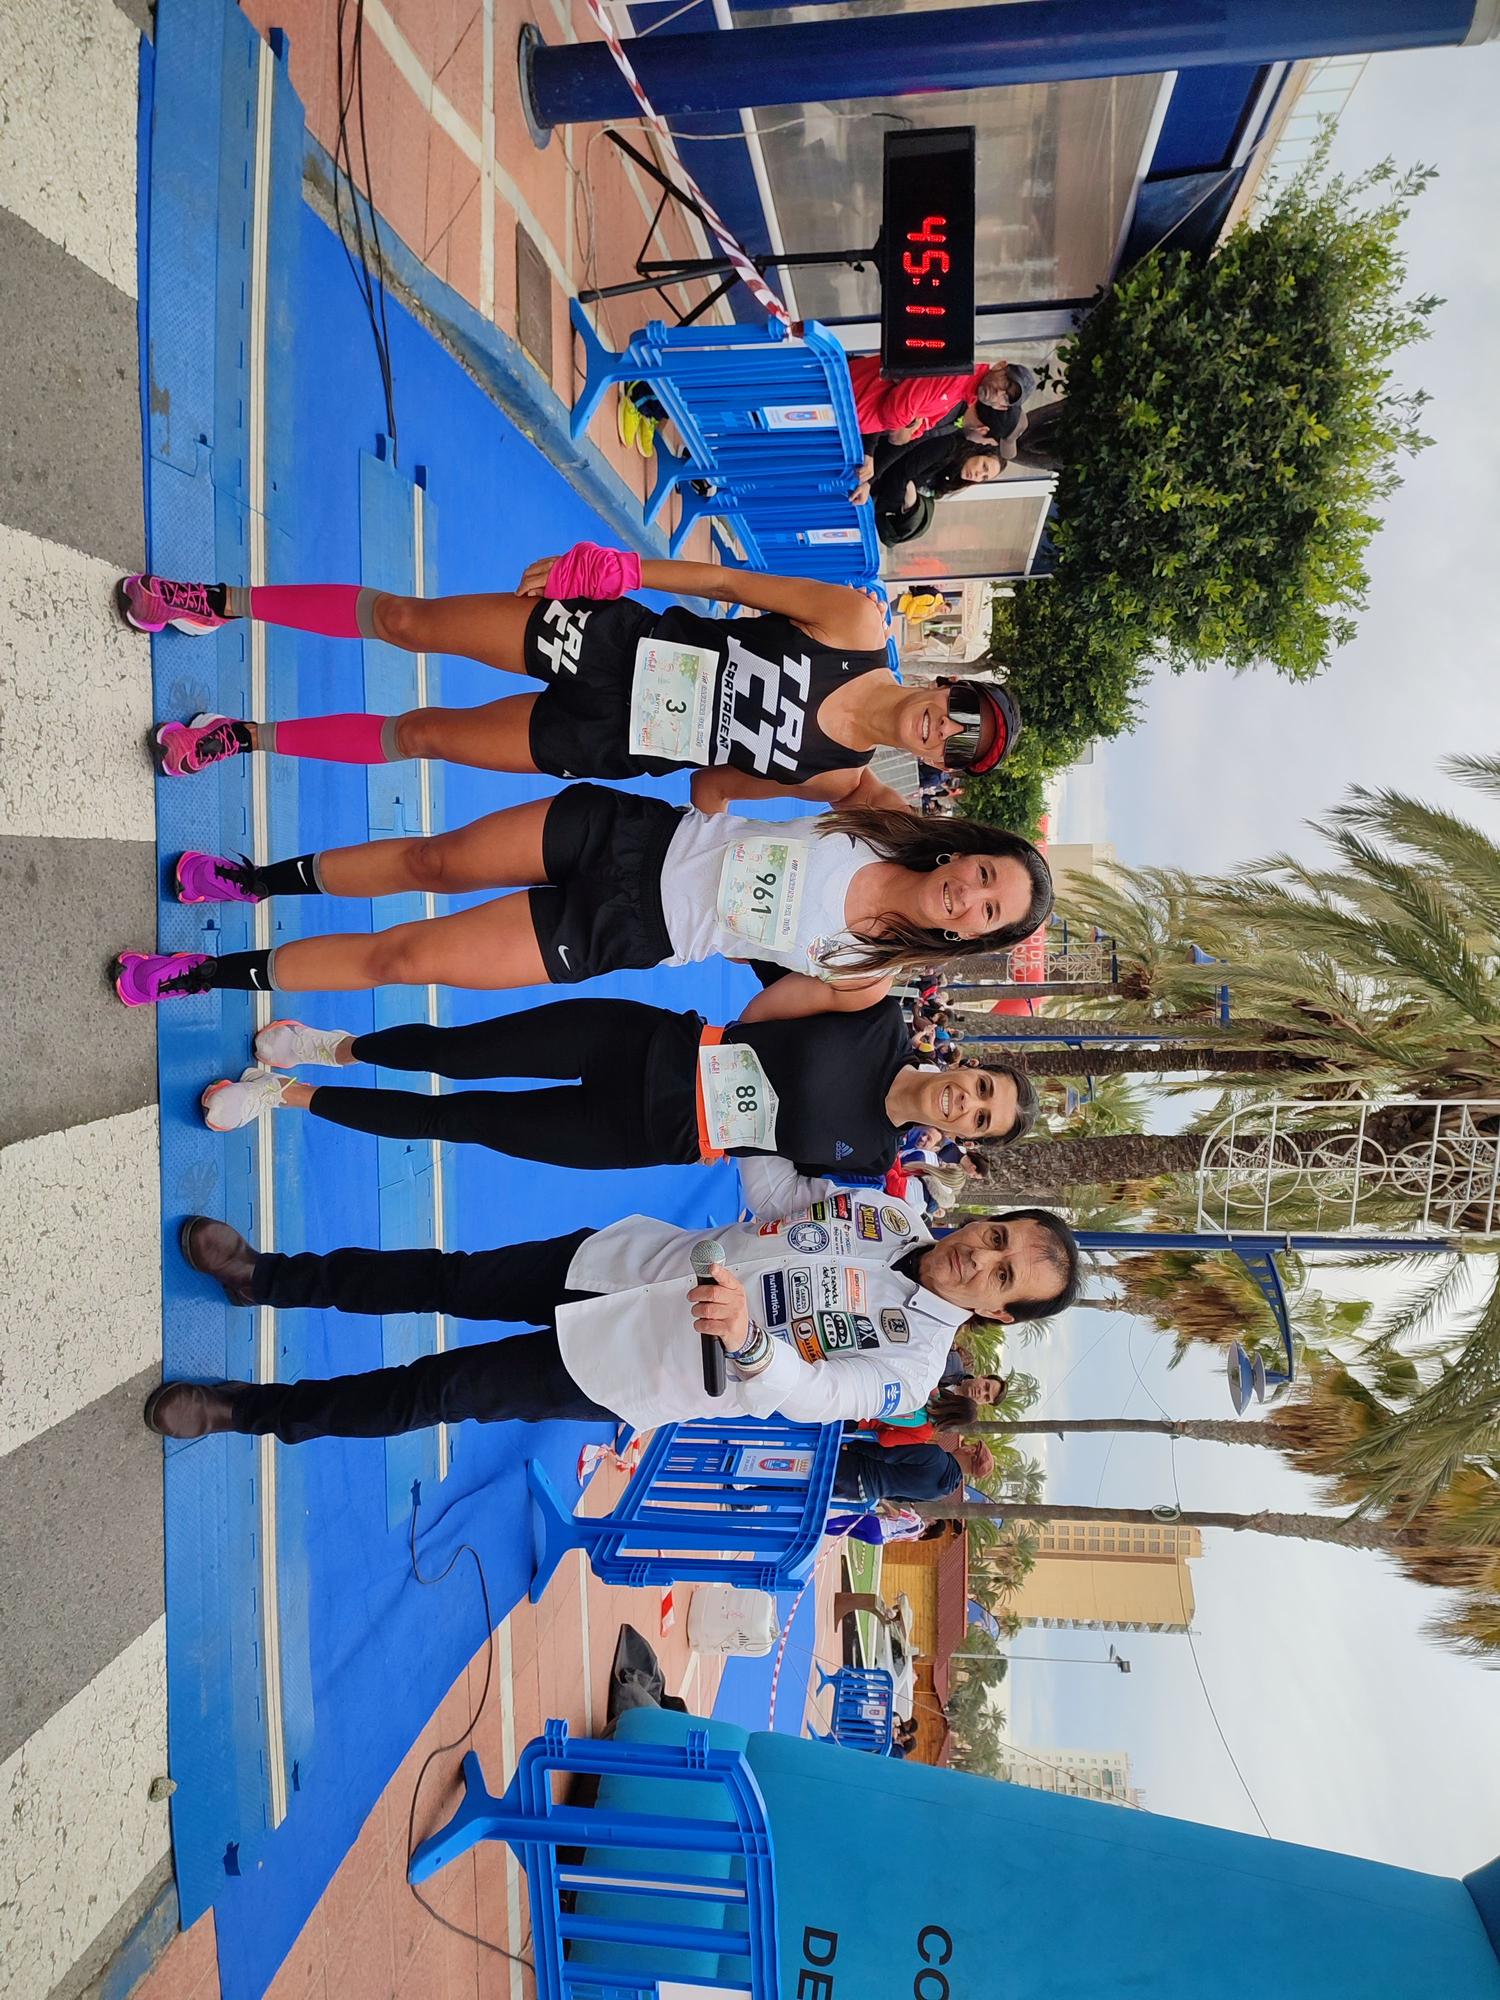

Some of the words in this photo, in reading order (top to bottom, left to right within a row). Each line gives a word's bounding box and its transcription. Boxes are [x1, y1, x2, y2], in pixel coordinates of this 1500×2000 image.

[902, 216, 950, 349] 45:11
[560, 609, 593, 675] TRI
[665, 699, 687, 714] 3
[729, 645, 781, 775] ET
[772, 653, 812, 772] TRI
[750, 873, 777, 914] 961
[1030, 951, 1042, 970] DE
[735, 1085, 758, 1113] 88
[860, 1206, 880, 1240] SHELDON
[822, 1266, 830, 1279] del
[823, 1317, 835, 1344] CERO
[835, 1315, 846, 1342] ONDA
